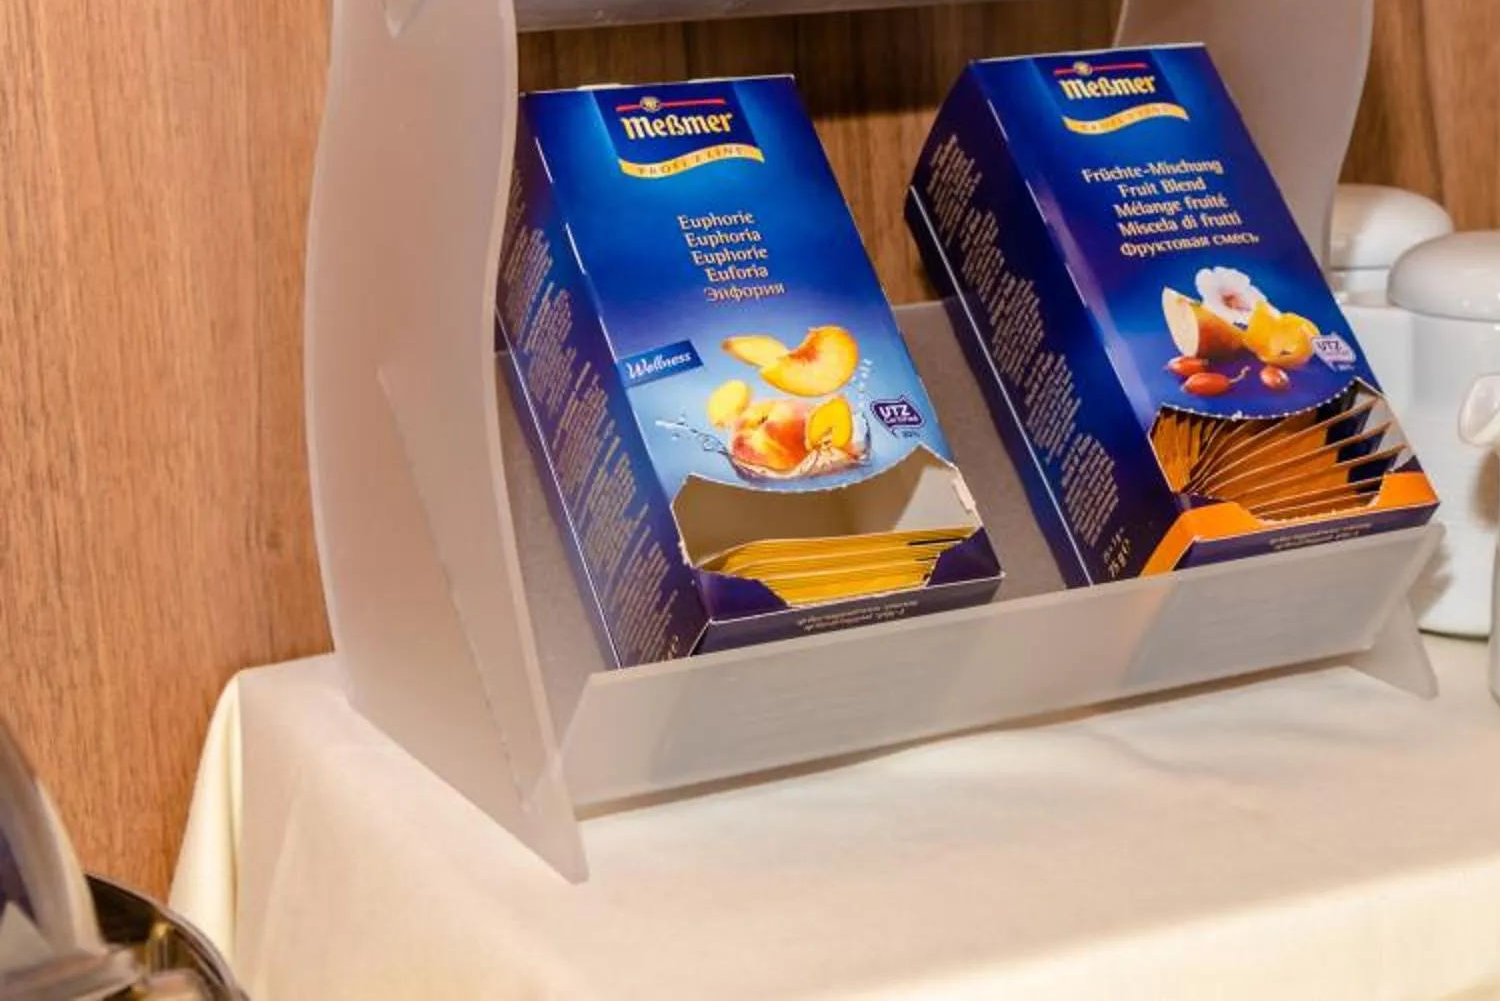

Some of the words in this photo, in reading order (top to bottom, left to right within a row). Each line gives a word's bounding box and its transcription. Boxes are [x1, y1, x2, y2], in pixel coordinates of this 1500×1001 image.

[1059, 75, 1155, 99] Meßmer
[621, 112, 733, 140] Meßmer
[1082, 159, 1224, 183] Früchte-Mischung
[1118, 182, 1157, 198] Fruit
[1160, 176, 1207, 193] Blend
[677, 210, 755, 231] Euphorie
[1113, 200, 1182, 219] Mélange
[1117, 217, 1178, 237] Miscela
[1182, 213, 1197, 230] di
[1201, 210, 1243, 227] frutti
[684, 228, 761, 248] Euphoria
[691, 244, 768, 267] Euphorie
[704, 264, 769, 282] Euforia
[625, 353, 691, 379] Wellness
[879, 405, 911, 418] UTZ
